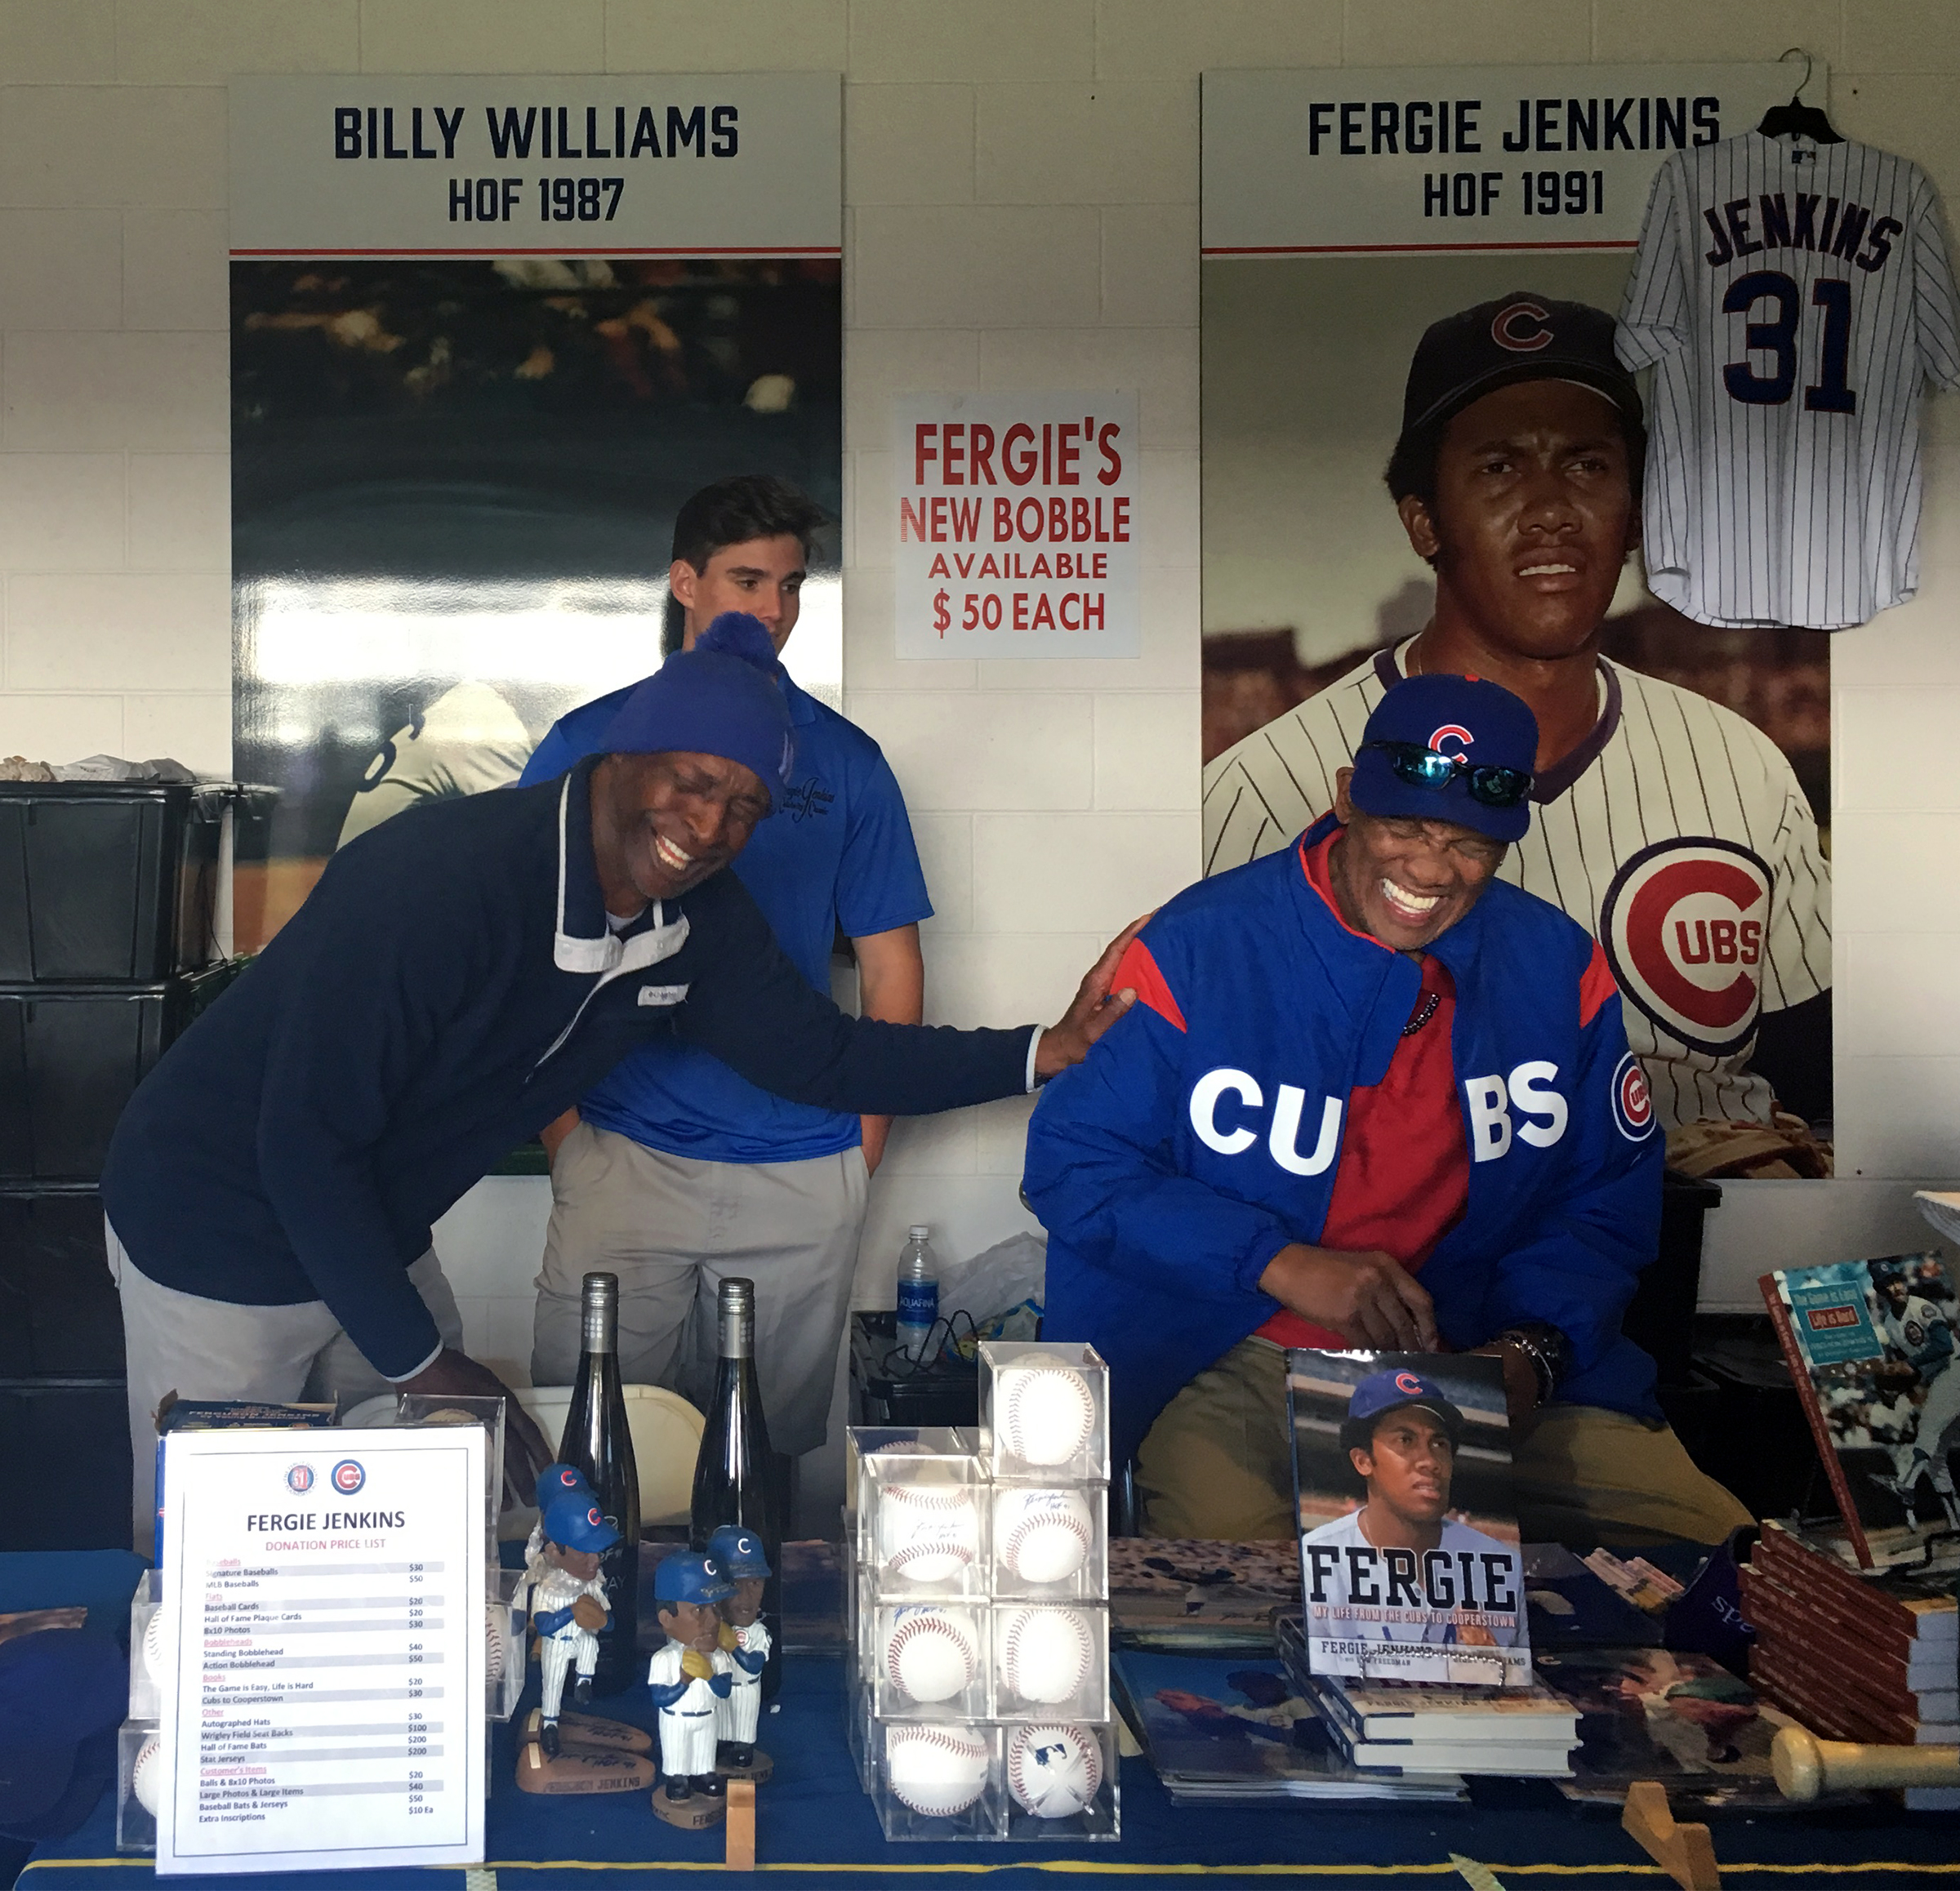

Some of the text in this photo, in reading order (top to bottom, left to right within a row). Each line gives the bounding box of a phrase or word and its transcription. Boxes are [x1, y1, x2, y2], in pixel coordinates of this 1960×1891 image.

[335, 105, 738, 159] BILLY WILLIAMS
[1308, 96, 1721, 156] FERGIE JENKINS
[449, 177, 625, 222] HOF 1987
[1423, 170, 1605, 218] HOF 1991
[1704, 193, 1904, 273] JENKINS
[1722, 270, 1856, 416] 31
[915, 416, 1122, 486] FERGIE'S
[901, 496, 1129, 542] NEW BOBBLE
[928, 553, 1107, 579] AVAILABLE
[1013, 592, 1104, 630] EACH
[900, 1297, 934, 1309] AQUAFINA
[247, 1511, 405, 1532] FERGIE JENKINS
[265, 1538, 386, 1551] DONATION PRICE LIST
[206, 1564, 423, 1578] Signature Baseballs $30
[409, 1575, 423, 1583] $50
[1307, 1544, 1517, 1613] FERGIE
[205, 1604, 236, 1612] Baseball
[409, 1597, 423, 1606] $20
[253, 1614, 279, 1622] Plaque
[409, 1620, 423, 1629] $30
[1313, 1606, 1516, 1628] MY LIFE FROM THE CUBS TO COOPERSTOWN
[203, 1650, 236, 1658] Standing
[409, 1643, 423, 1651] $40
[1321, 1641, 1368, 1655] FERGIE
[203, 1655, 423, 1670] Action Bobblehead $50
[203, 1674, 225, 1682] Books
[251, 1684, 270, 1692] Easy,
[408, 1678, 423, 1686] $20
[233, 1695, 283, 1704] Cooperstown
[408, 1689, 423, 1697] $30
[202, 1708, 224, 1718] Other
[202, 1719, 252, 1729] Autographed
[408, 1713, 423, 1721] $30
[201, 1732, 230, 1741] Wrigley
[408, 1724, 427, 1733] $100
[408, 1736, 427, 1744] $200
[218, 1755, 245, 1764] Jerseys
[408, 1747, 427, 1756] $200
[409, 1771, 423, 1779] $20
[597, 1776, 640, 1790] JENKINS
[200, 1791, 220, 1800] Large
[260, 1789, 280, 1797] Large
[409, 1782, 423, 1791] $40
[199, 1803, 231, 1811] Baseball
[409, 1795, 423, 1803] $50
[221, 1813, 265, 1822] Inscriptions
[409, 1806, 423, 1815] $10
